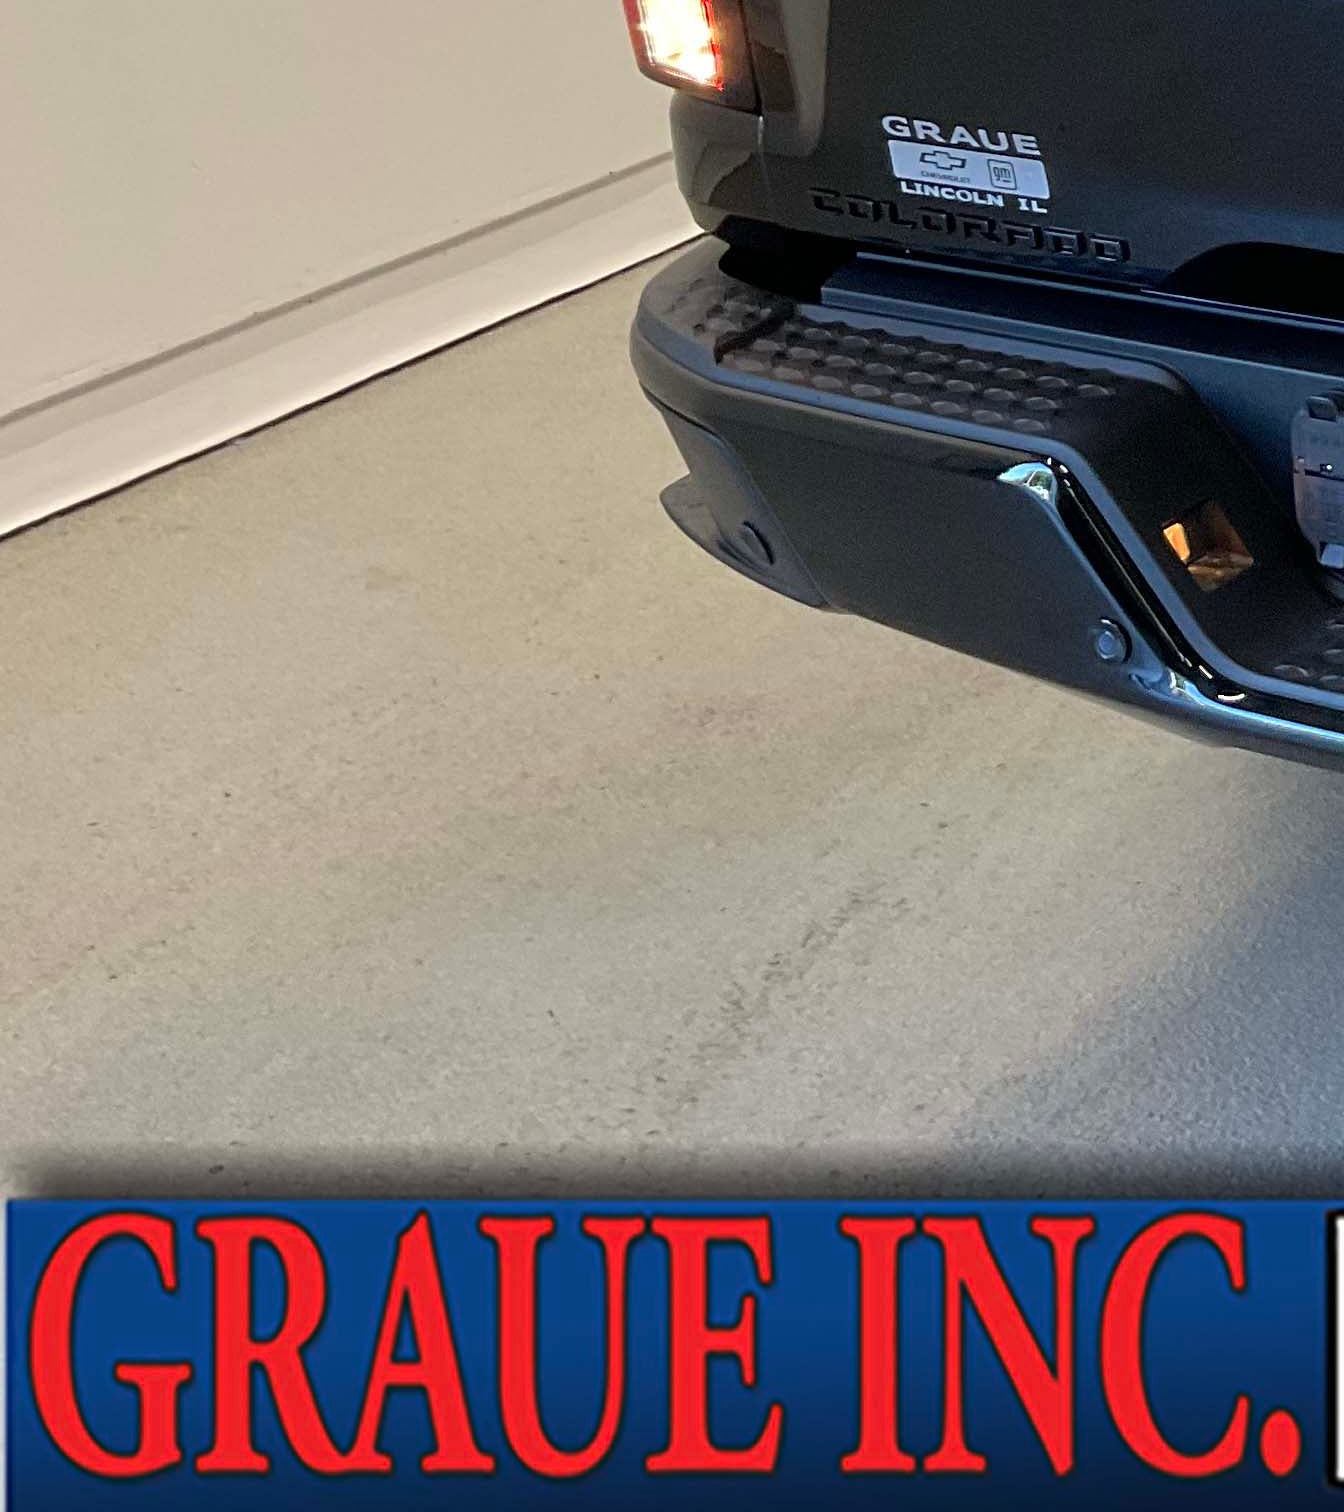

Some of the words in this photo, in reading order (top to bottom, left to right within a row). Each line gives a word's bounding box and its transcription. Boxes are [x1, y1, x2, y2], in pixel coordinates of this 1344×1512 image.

[881, 114, 1042, 156] GRAUE
[901, 181, 1005, 208] LINCOLN
[1018, 197, 1048, 214] IL
[808, 188, 1132, 264] COLORADO
